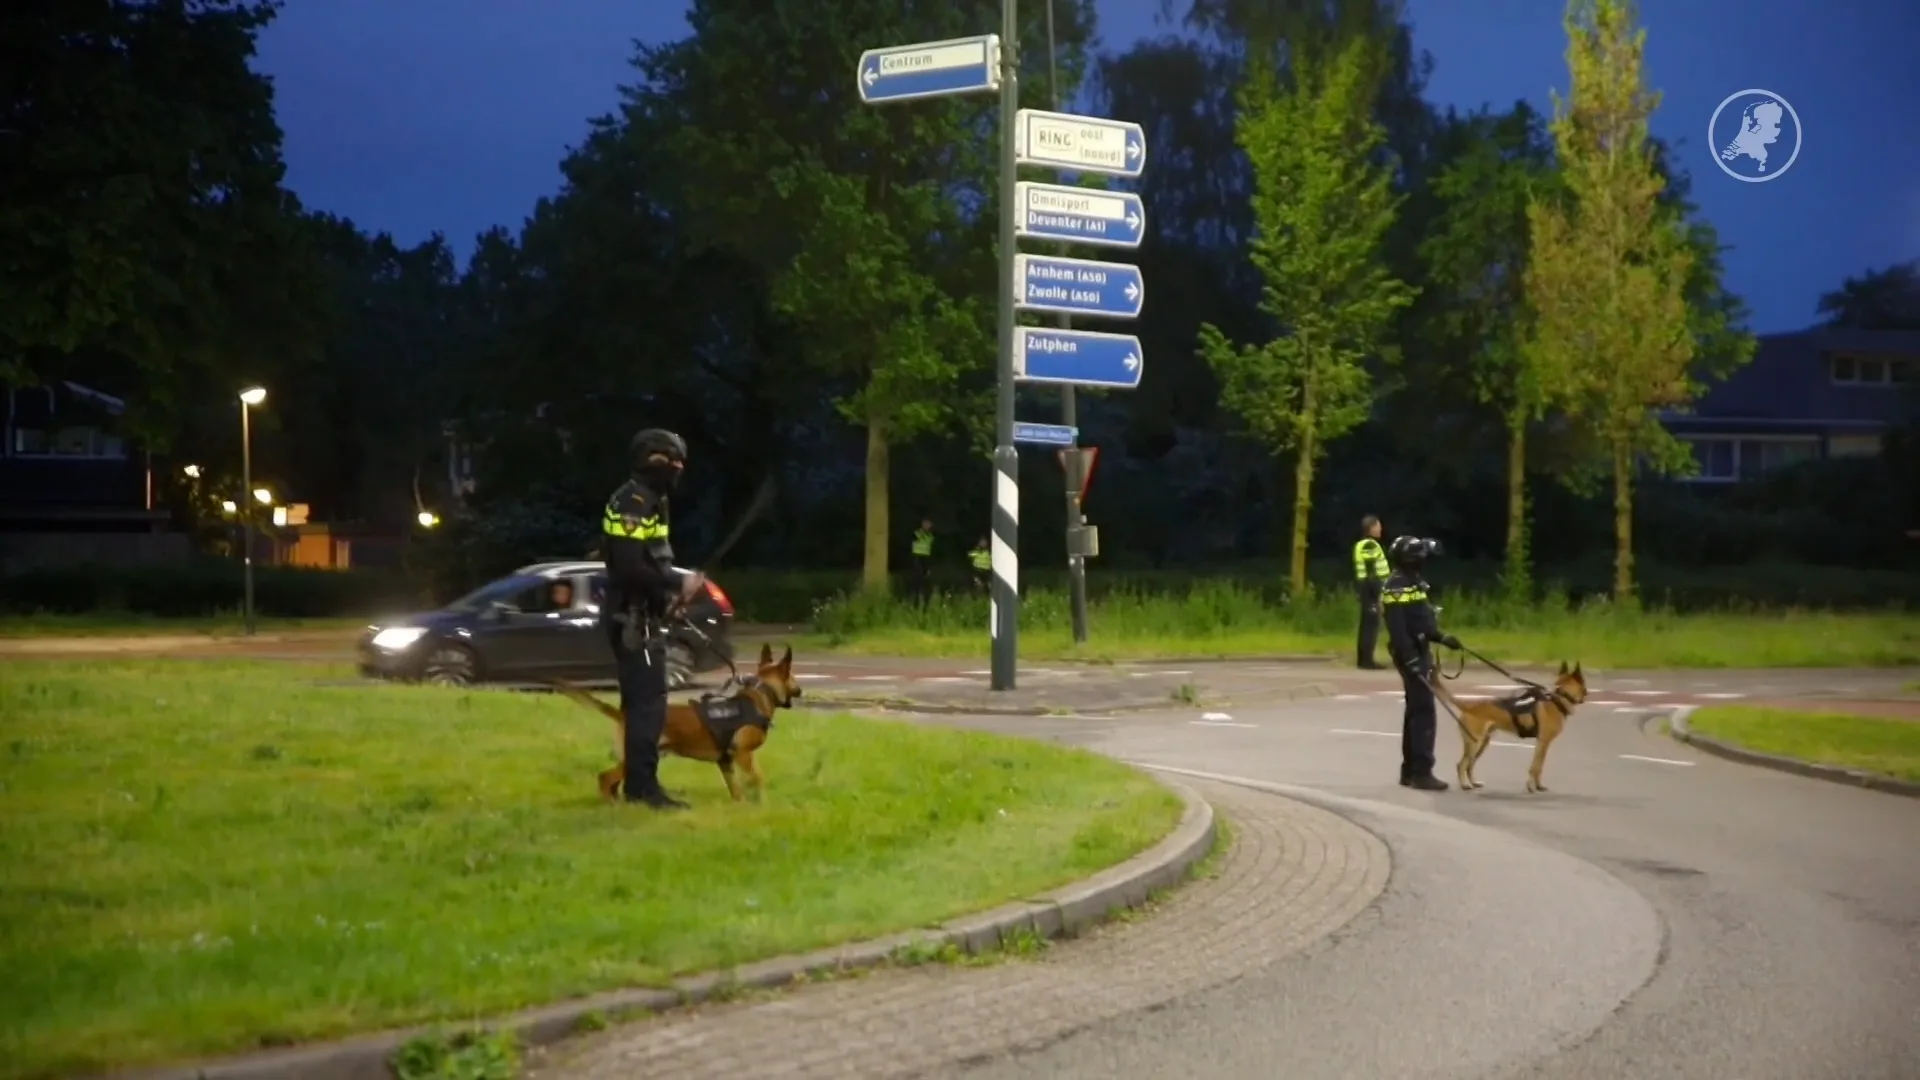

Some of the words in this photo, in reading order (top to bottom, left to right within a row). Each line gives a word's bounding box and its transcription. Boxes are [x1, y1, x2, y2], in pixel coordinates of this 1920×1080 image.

[882, 54, 933, 70] Centrum
[1039, 130, 1072, 146] RING
[1031, 192, 1090, 211] Omnisport
[1028, 211, 1082, 231] Deventer
[1085, 218, 1106, 233] (A1)
[1028, 264, 1074, 281] Arnhem
[1028, 283, 1068, 300] Zwolle
[1027, 335, 1077, 354] Zutphen
